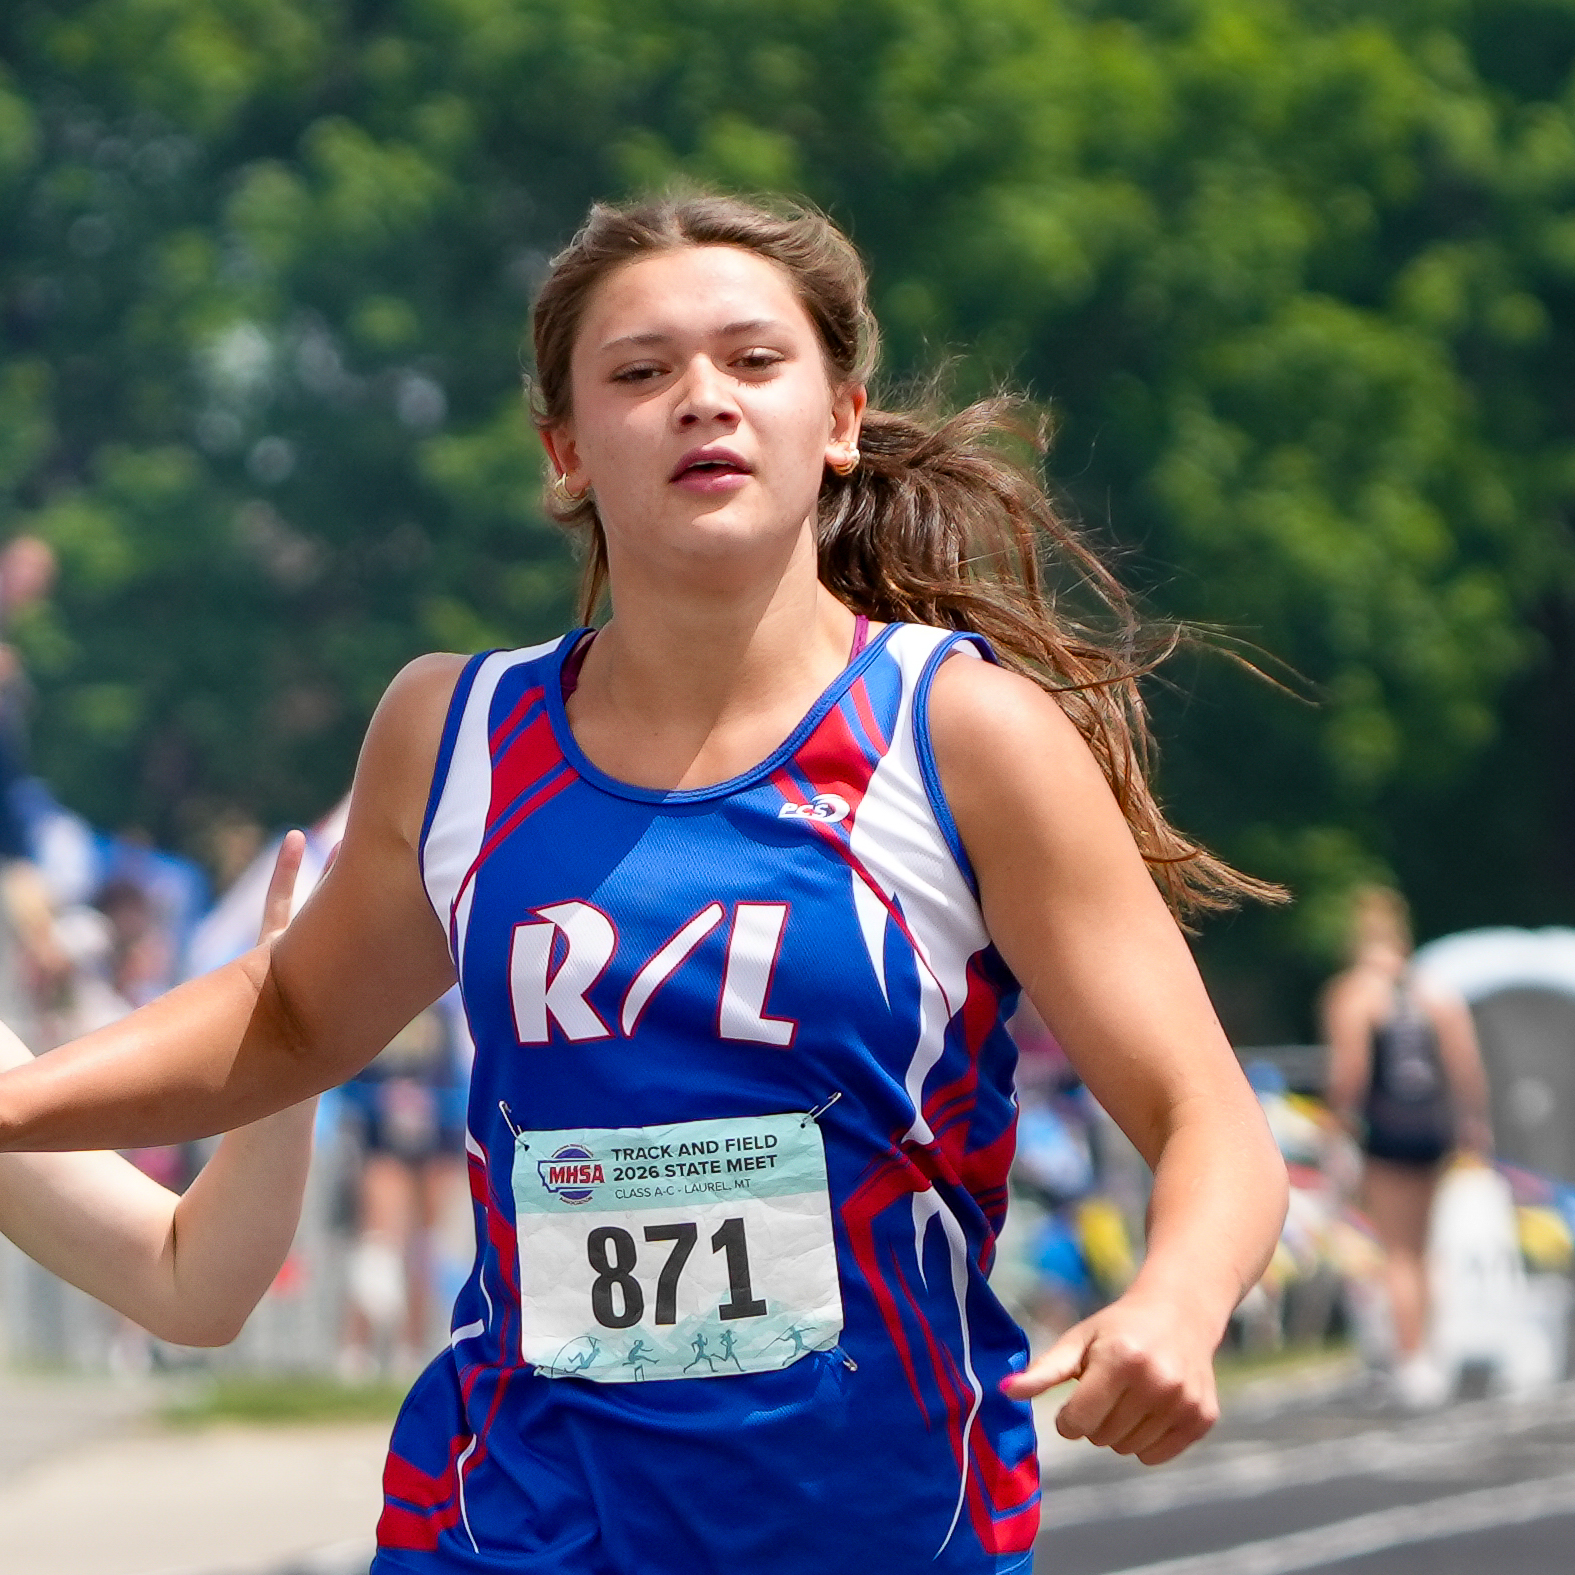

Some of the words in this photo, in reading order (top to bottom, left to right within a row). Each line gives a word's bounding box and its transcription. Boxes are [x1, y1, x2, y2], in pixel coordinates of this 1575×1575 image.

[508, 898, 799, 1048] R/L
[611, 1144, 673, 1162] TRACK
[678, 1140, 719, 1158] AND
[725, 1134, 778, 1153] FIELD
[549, 1163, 606, 1184] MHSA
[613, 1166, 660, 1182] 2026
[664, 1160, 722, 1178] STATE
[727, 1154, 778, 1173] MEET
[615, 1187, 652, 1199] CLASS
[654, 1185, 675, 1197] A-C
[734, 1178, 752, 1189] MT
[587, 1217, 767, 1329] 871
